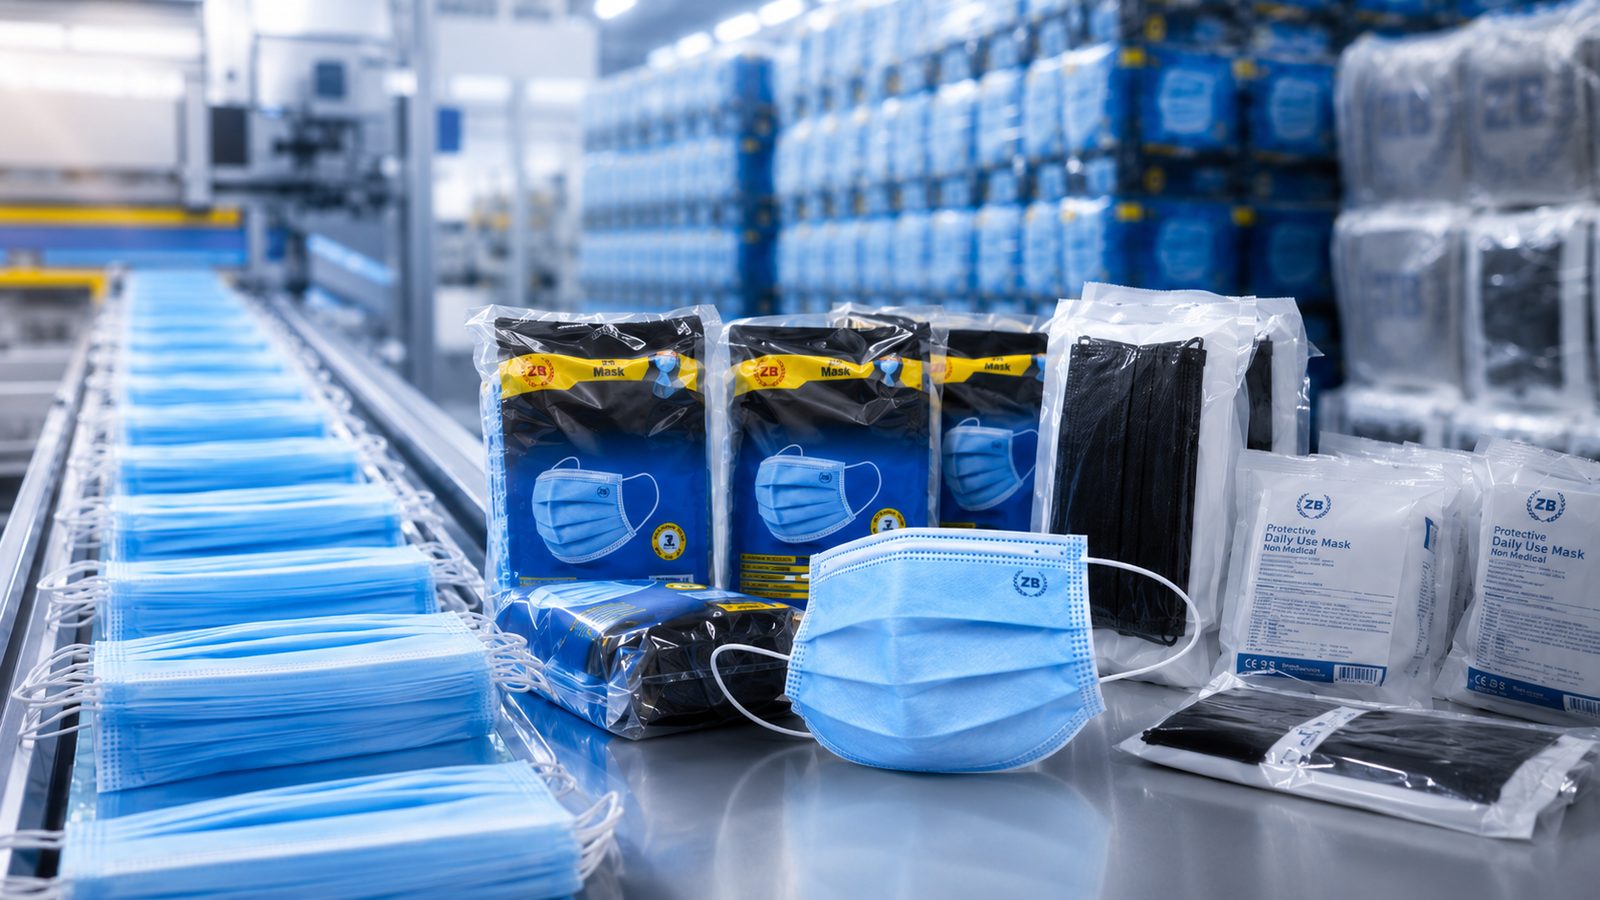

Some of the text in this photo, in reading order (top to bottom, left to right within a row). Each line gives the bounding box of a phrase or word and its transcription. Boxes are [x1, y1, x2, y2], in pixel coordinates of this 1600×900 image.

[527, 364, 547, 378] ZB
[593, 366, 625, 377] Mask
[760, 365, 778, 377] ZB
[821, 366, 851, 377] Mask
[984, 362, 1011, 372] Mask
[1303, 499, 1324, 511] ZB
[1534, 498, 1557, 512] ZB
[1266, 523, 1316, 536] Protective
[1494, 525, 1547, 542] Protective
[1264, 533, 1352, 550] Daily Use Mask
[1492, 535, 1585, 560] Daily Use Mask
[1263, 544, 1317, 556] Non Medical
[1490, 548, 1547, 564] Non Medical
[1020, 576, 1041, 589] ZB
[1245, 658, 1257, 669] CE
[1474, 674, 1487, 687] CE
